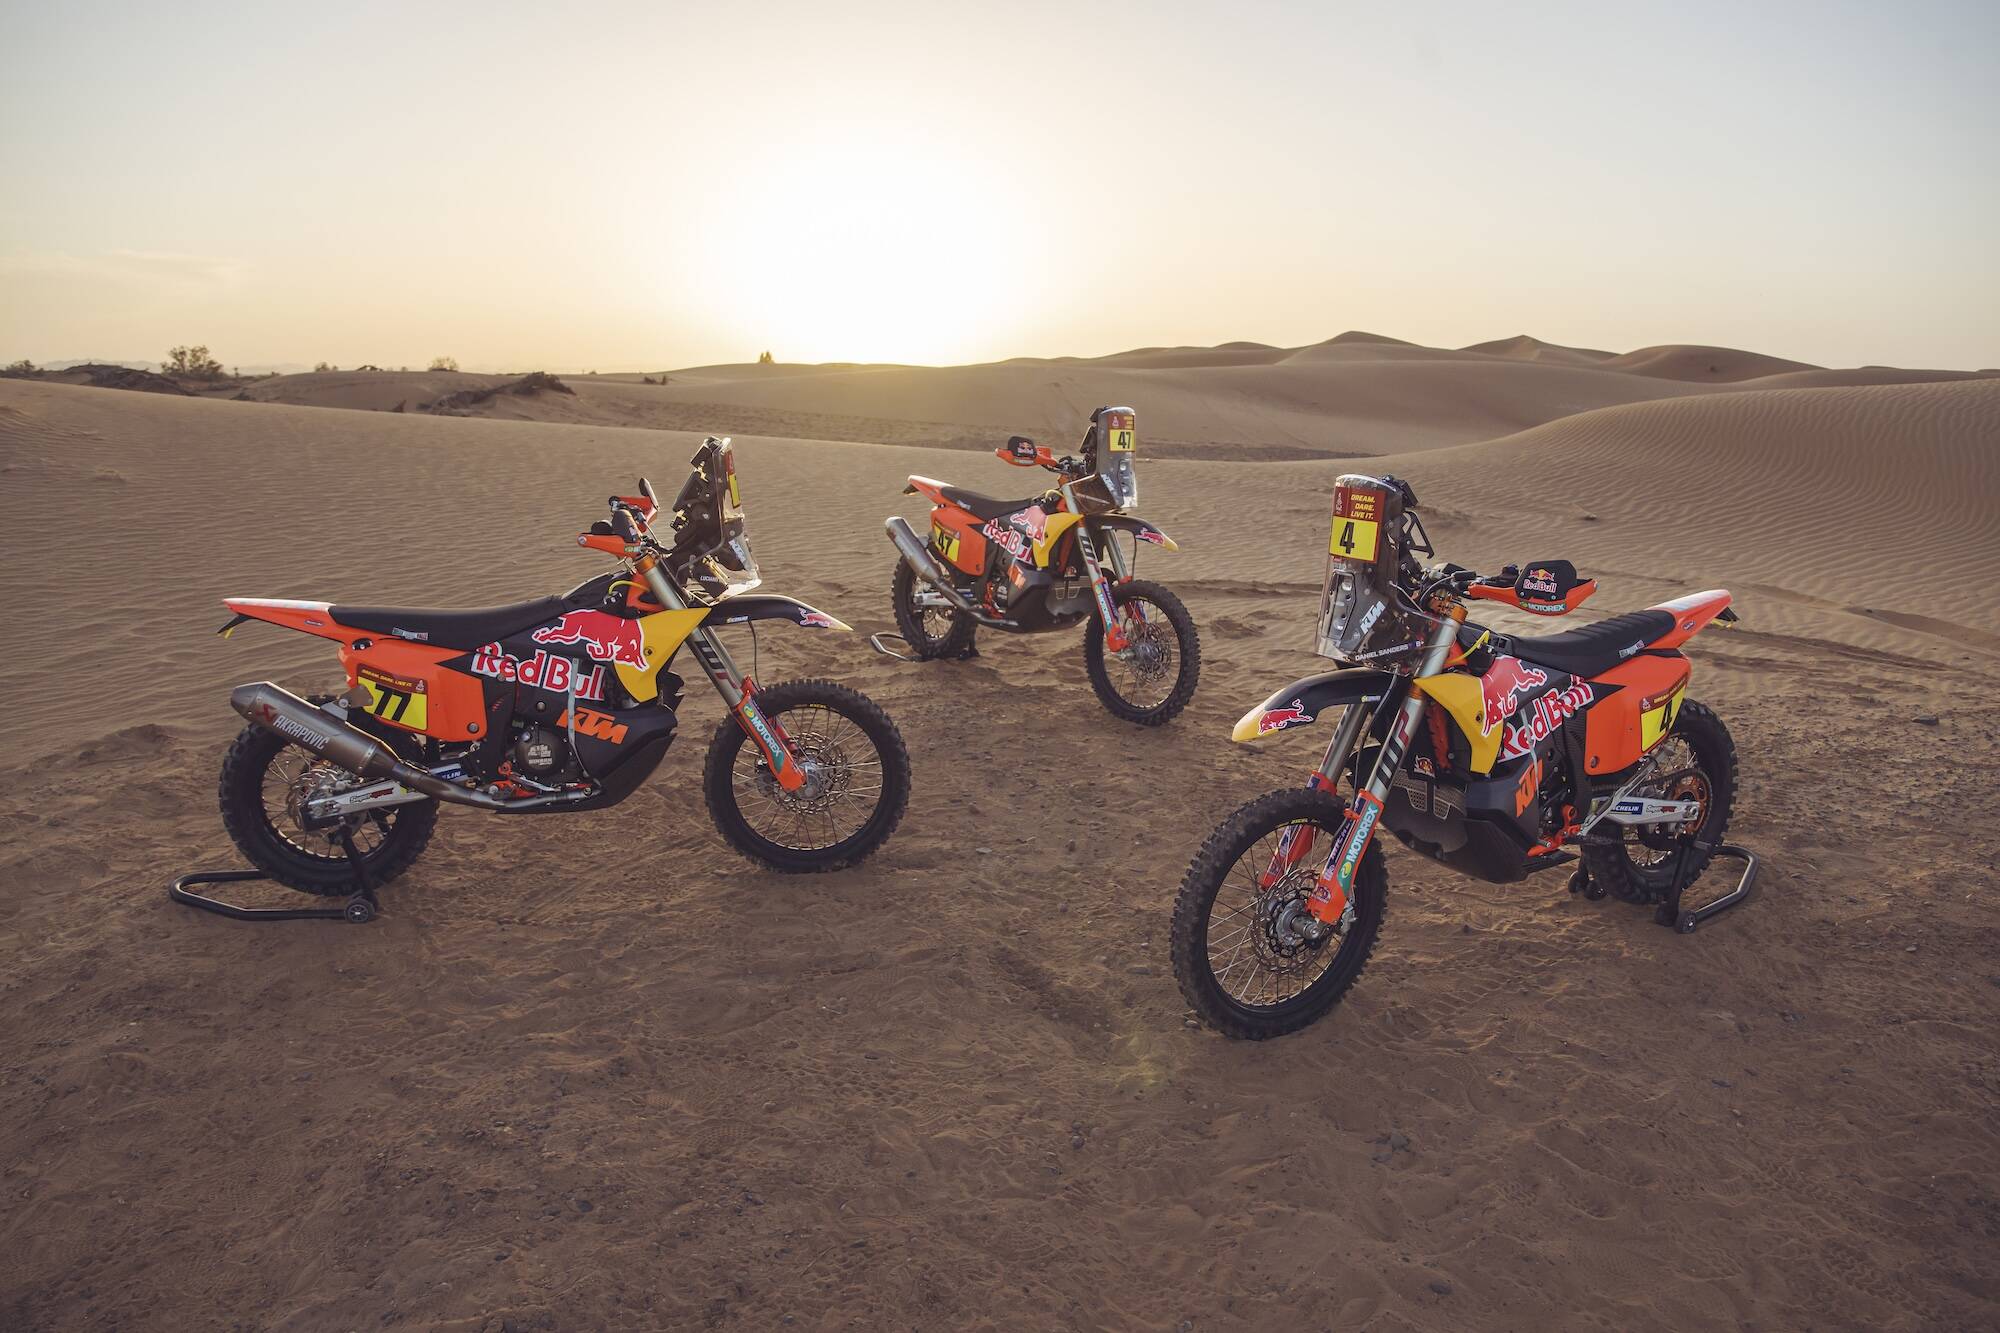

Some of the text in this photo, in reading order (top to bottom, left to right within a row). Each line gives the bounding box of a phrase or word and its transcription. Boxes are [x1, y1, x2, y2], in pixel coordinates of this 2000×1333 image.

[1117, 431, 1131, 449] 47
[1350, 494, 1376, 503] DREAM.
[1350, 510, 1374, 520] LIVE IT.
[1355, 503, 1375, 511] DARE.
[938, 529, 953, 556] 47
[1340, 521, 1355, 554] 4
[1523, 579, 1557, 593] Red Bull
[1360, 601, 1386, 634] KTM
[1528, 603, 1565, 611] MOTOREX
[471, 641, 547, 687] Red
[1355, 651, 1378, 661] DANIEL
[1378, 643, 1408, 656] SANDERS
[375, 683, 412, 722] 77
[1660, 700, 1672, 733] 4
[556, 706, 629, 745] KTM
[751, 716, 784, 757] MOTOREX
[1497, 698, 1550, 763] Red
[1346, 807, 1379, 862] MOTOREX
